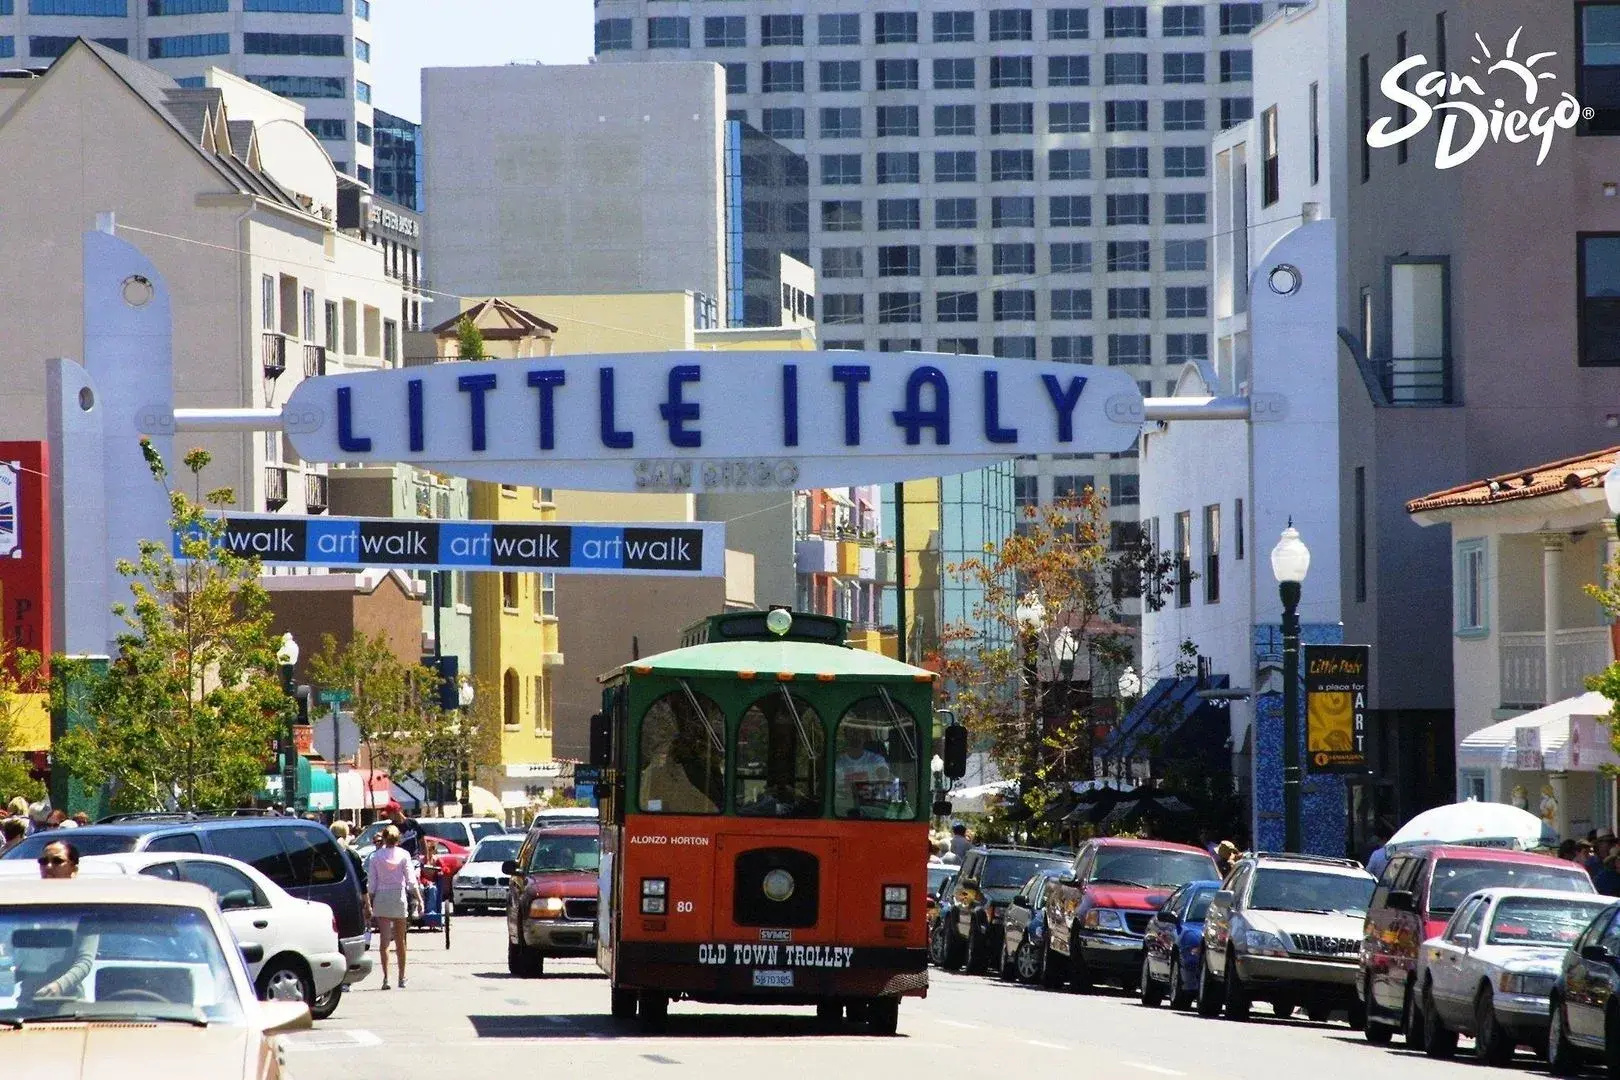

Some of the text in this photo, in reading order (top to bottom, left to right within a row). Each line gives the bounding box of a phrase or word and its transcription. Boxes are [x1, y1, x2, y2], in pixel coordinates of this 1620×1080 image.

[337, 364, 1088, 452] LITTLE ITALY
[634, 458, 800, 488] SAN DIEGO
[1326, 683, 1350, 692] place
[1355, 692, 1365, 752] ART
[630, 836, 709, 846] ALONZO HORTON
[676, 901, 693, 912] 80
[698, 944, 853, 967] OLD TOWN TROLLEY
